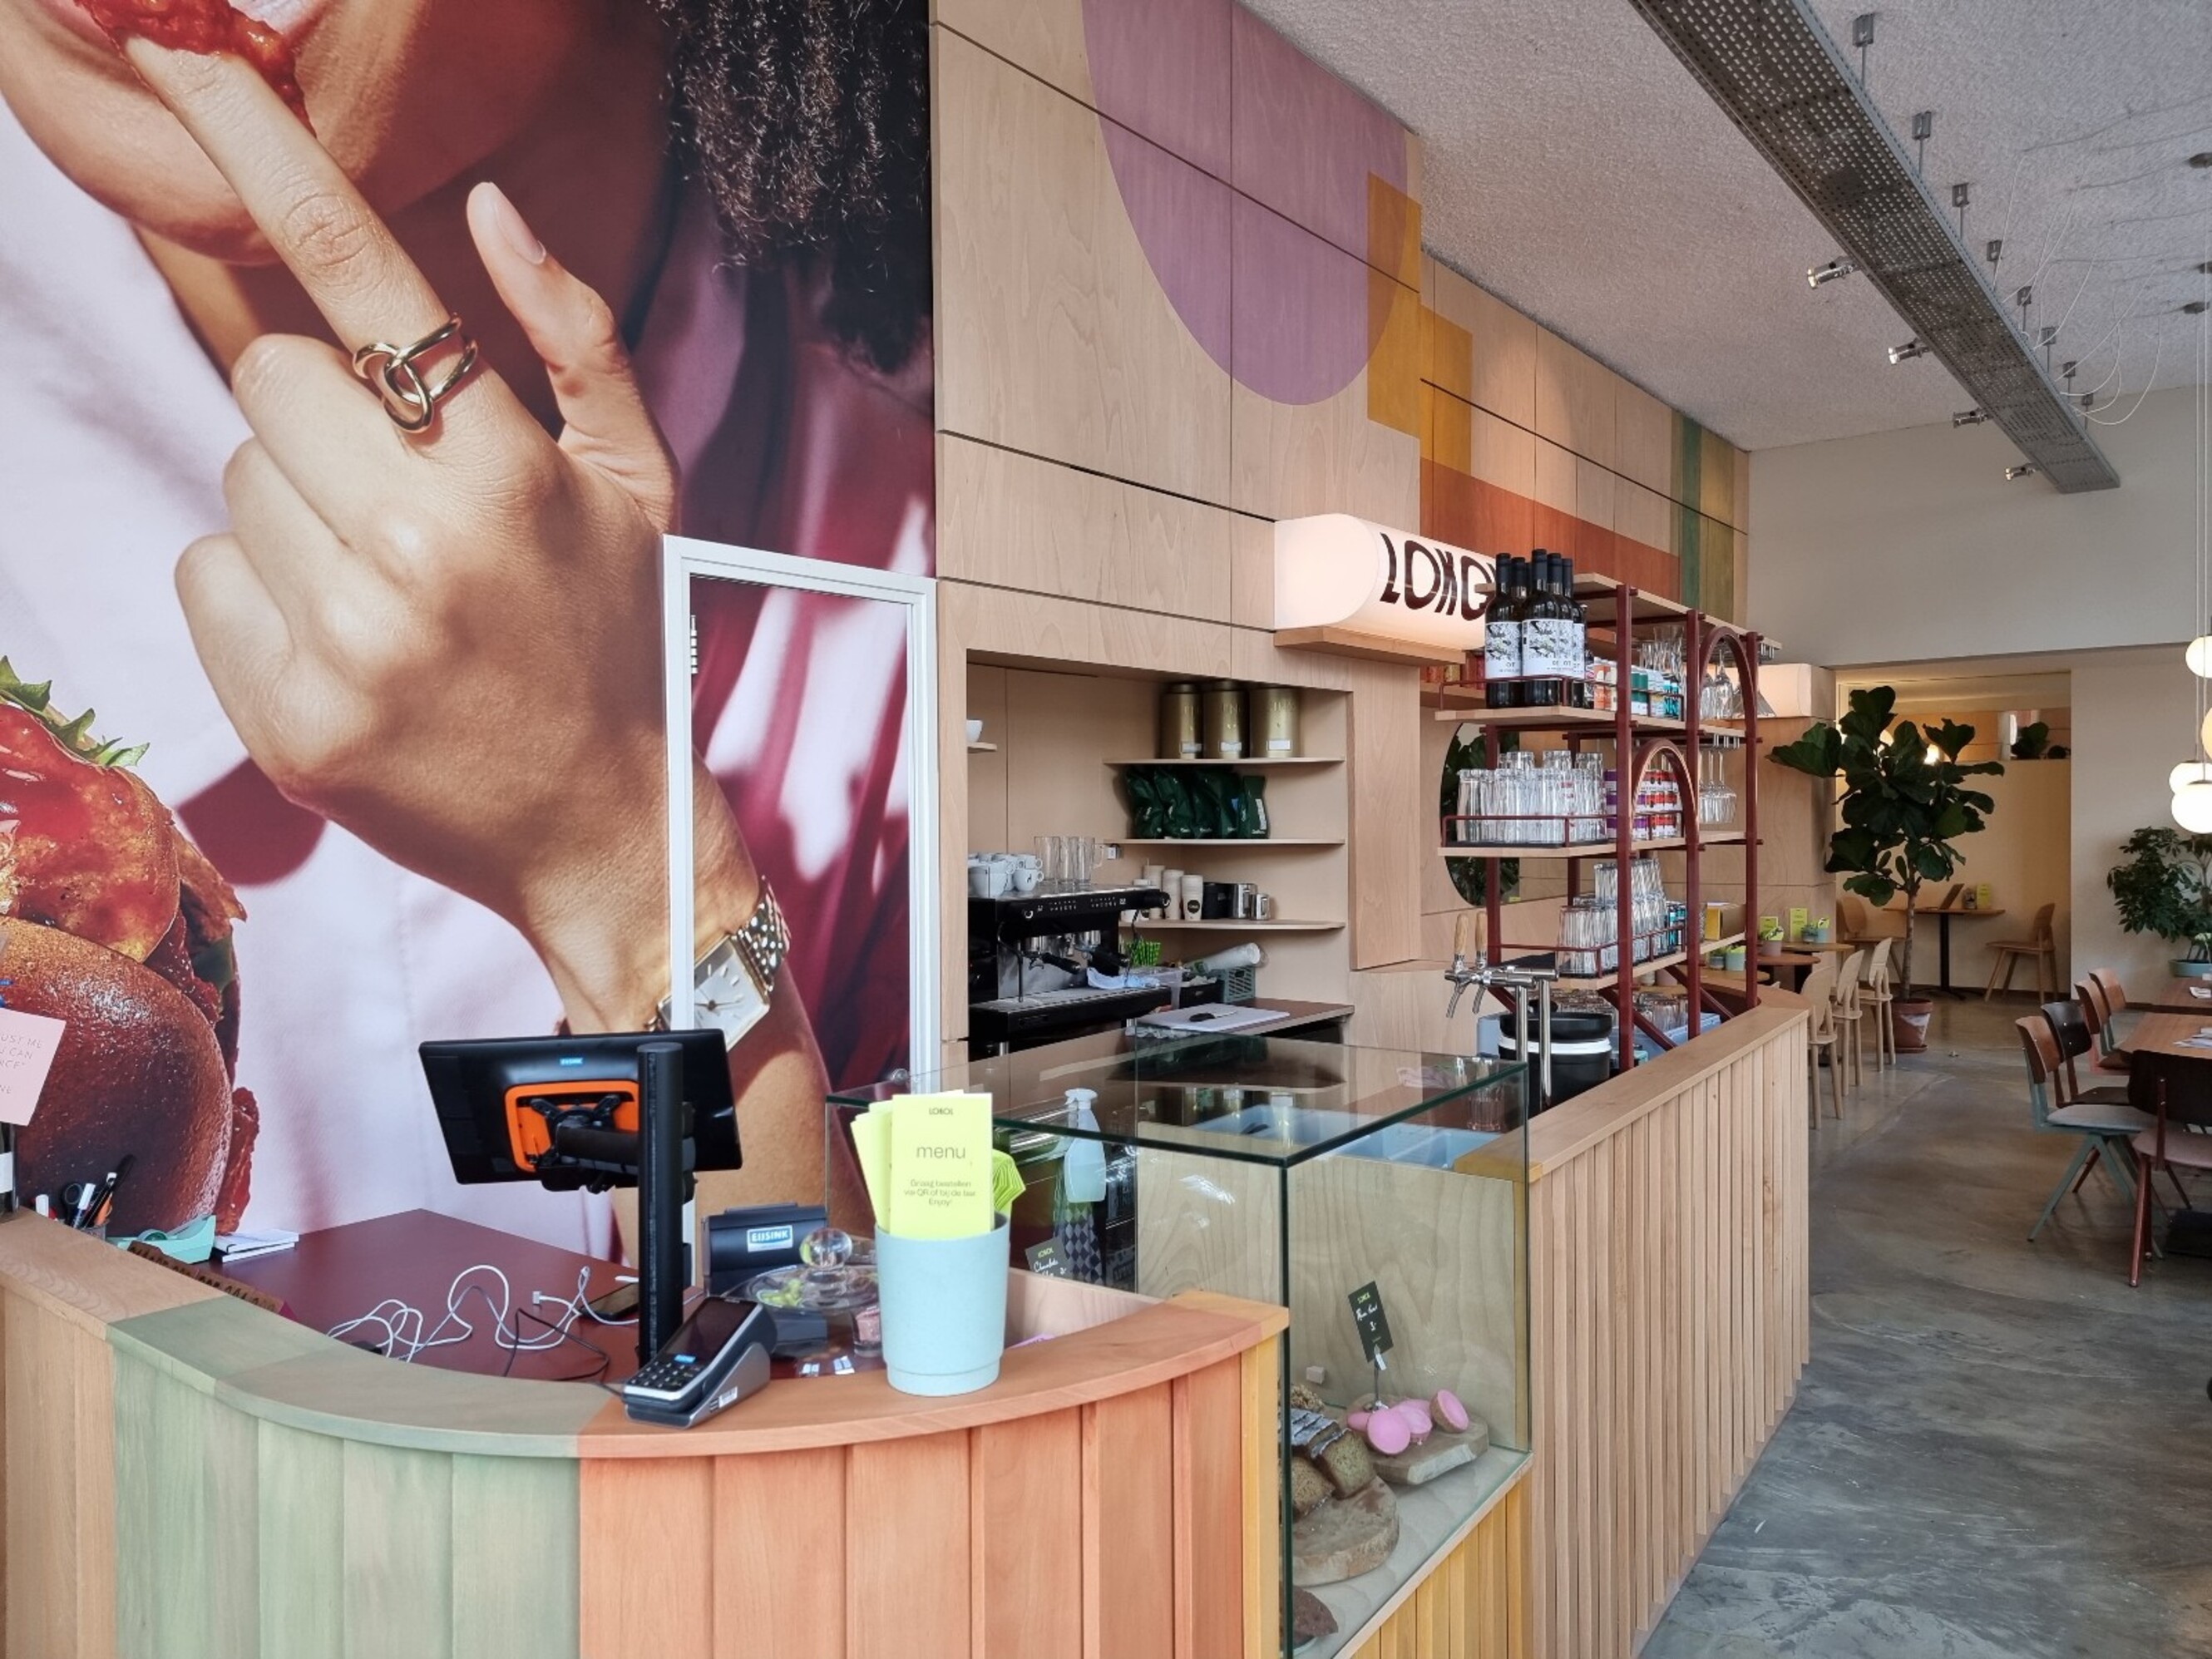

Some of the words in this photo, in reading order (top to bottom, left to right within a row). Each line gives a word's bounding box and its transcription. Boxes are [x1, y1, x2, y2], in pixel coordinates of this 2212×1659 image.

[1379, 532, 1497, 621] LOKO
[916, 1146, 965, 1159] menu
[910, 1178, 935, 1188] Graag
[936, 1179, 971, 1187] bestellen
[916, 1188, 928, 1197] QR
